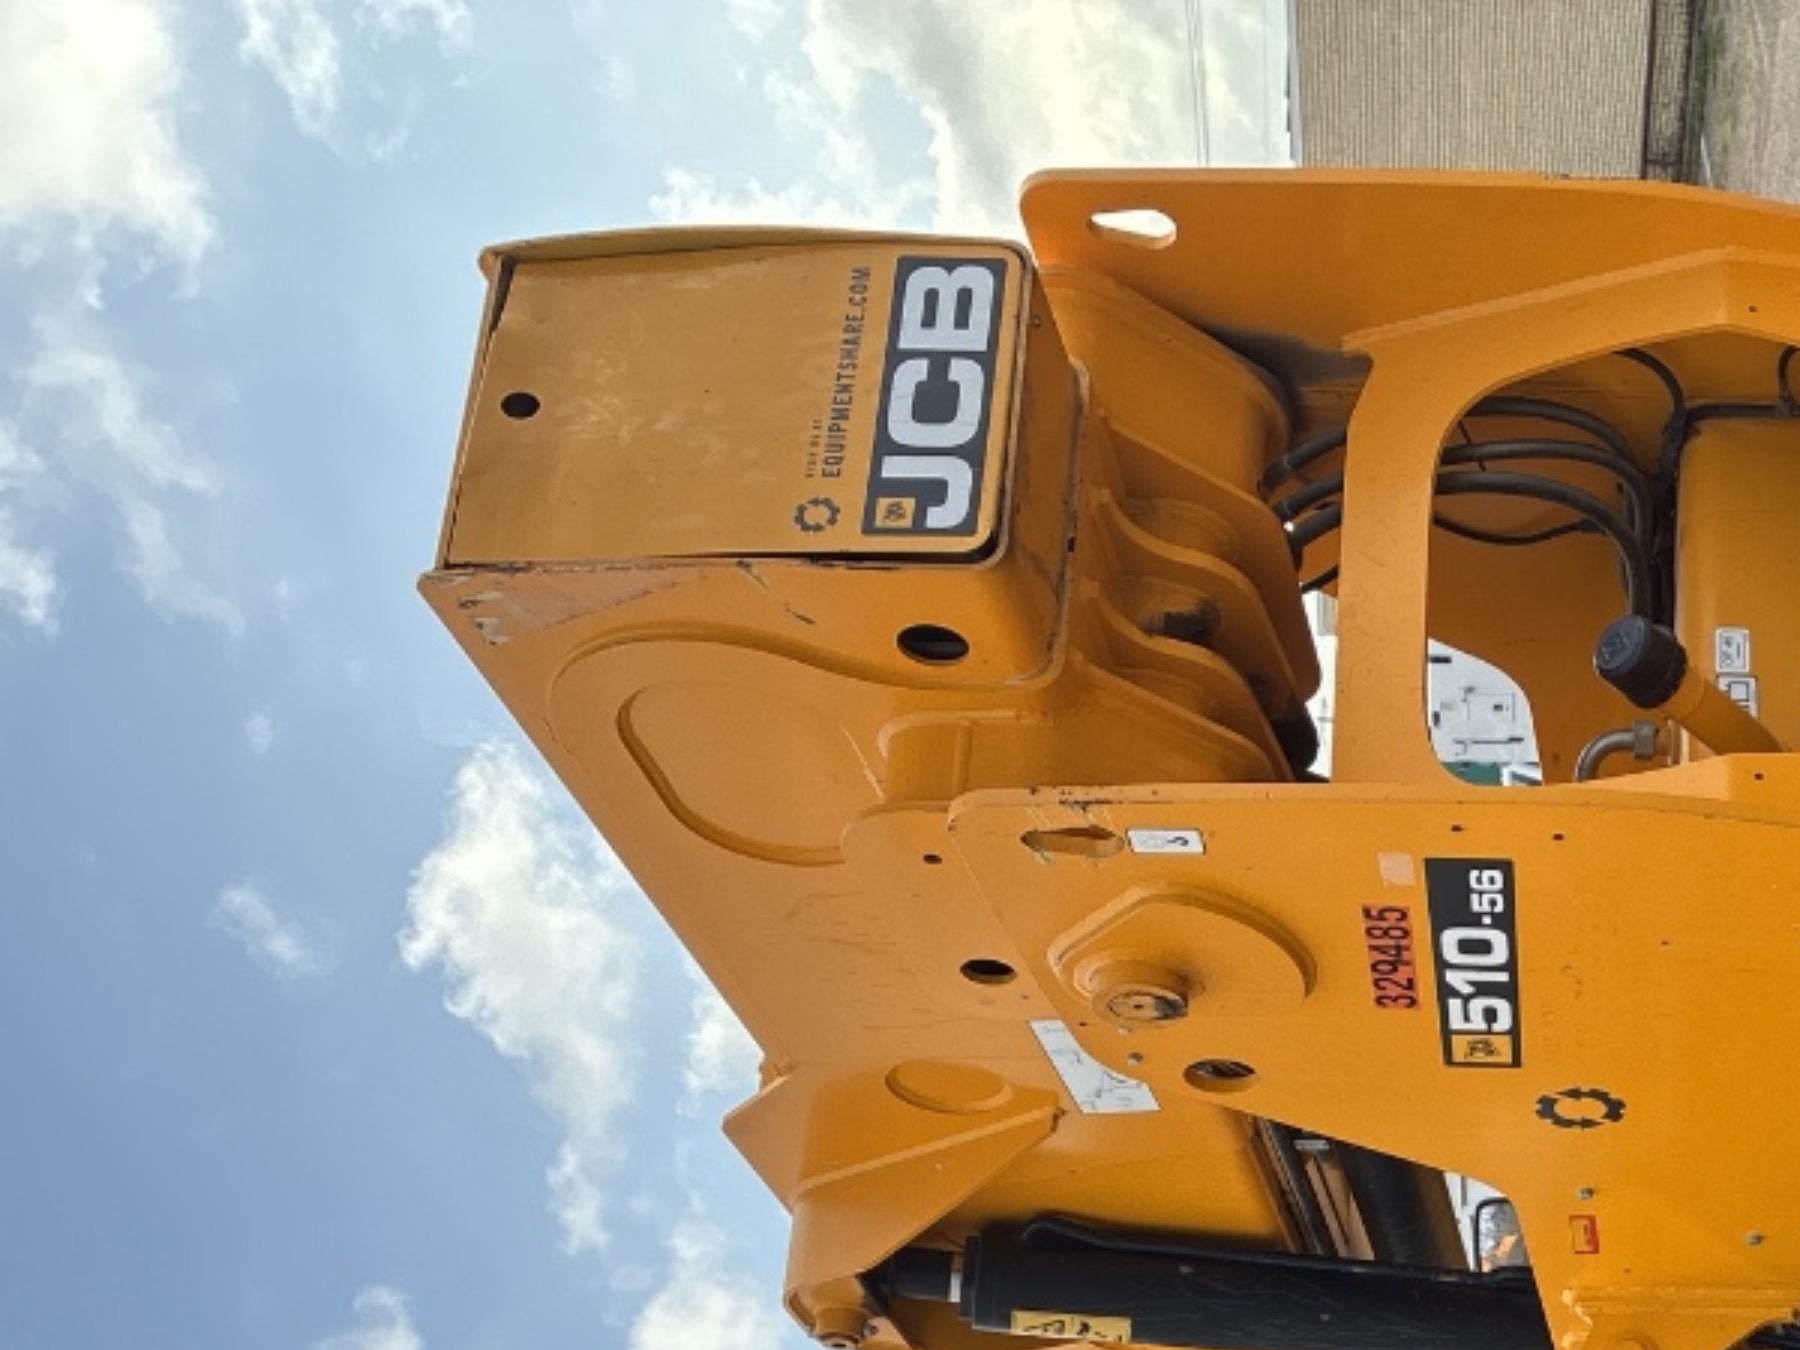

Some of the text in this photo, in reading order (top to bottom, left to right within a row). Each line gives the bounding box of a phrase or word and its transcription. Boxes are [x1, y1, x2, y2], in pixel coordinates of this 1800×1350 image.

[821, 267, 870, 478] EQUIPMENTSHARE.COM
[881, 265, 995, 529] JCB
[1361, 905, 1417, 1008] 329485
